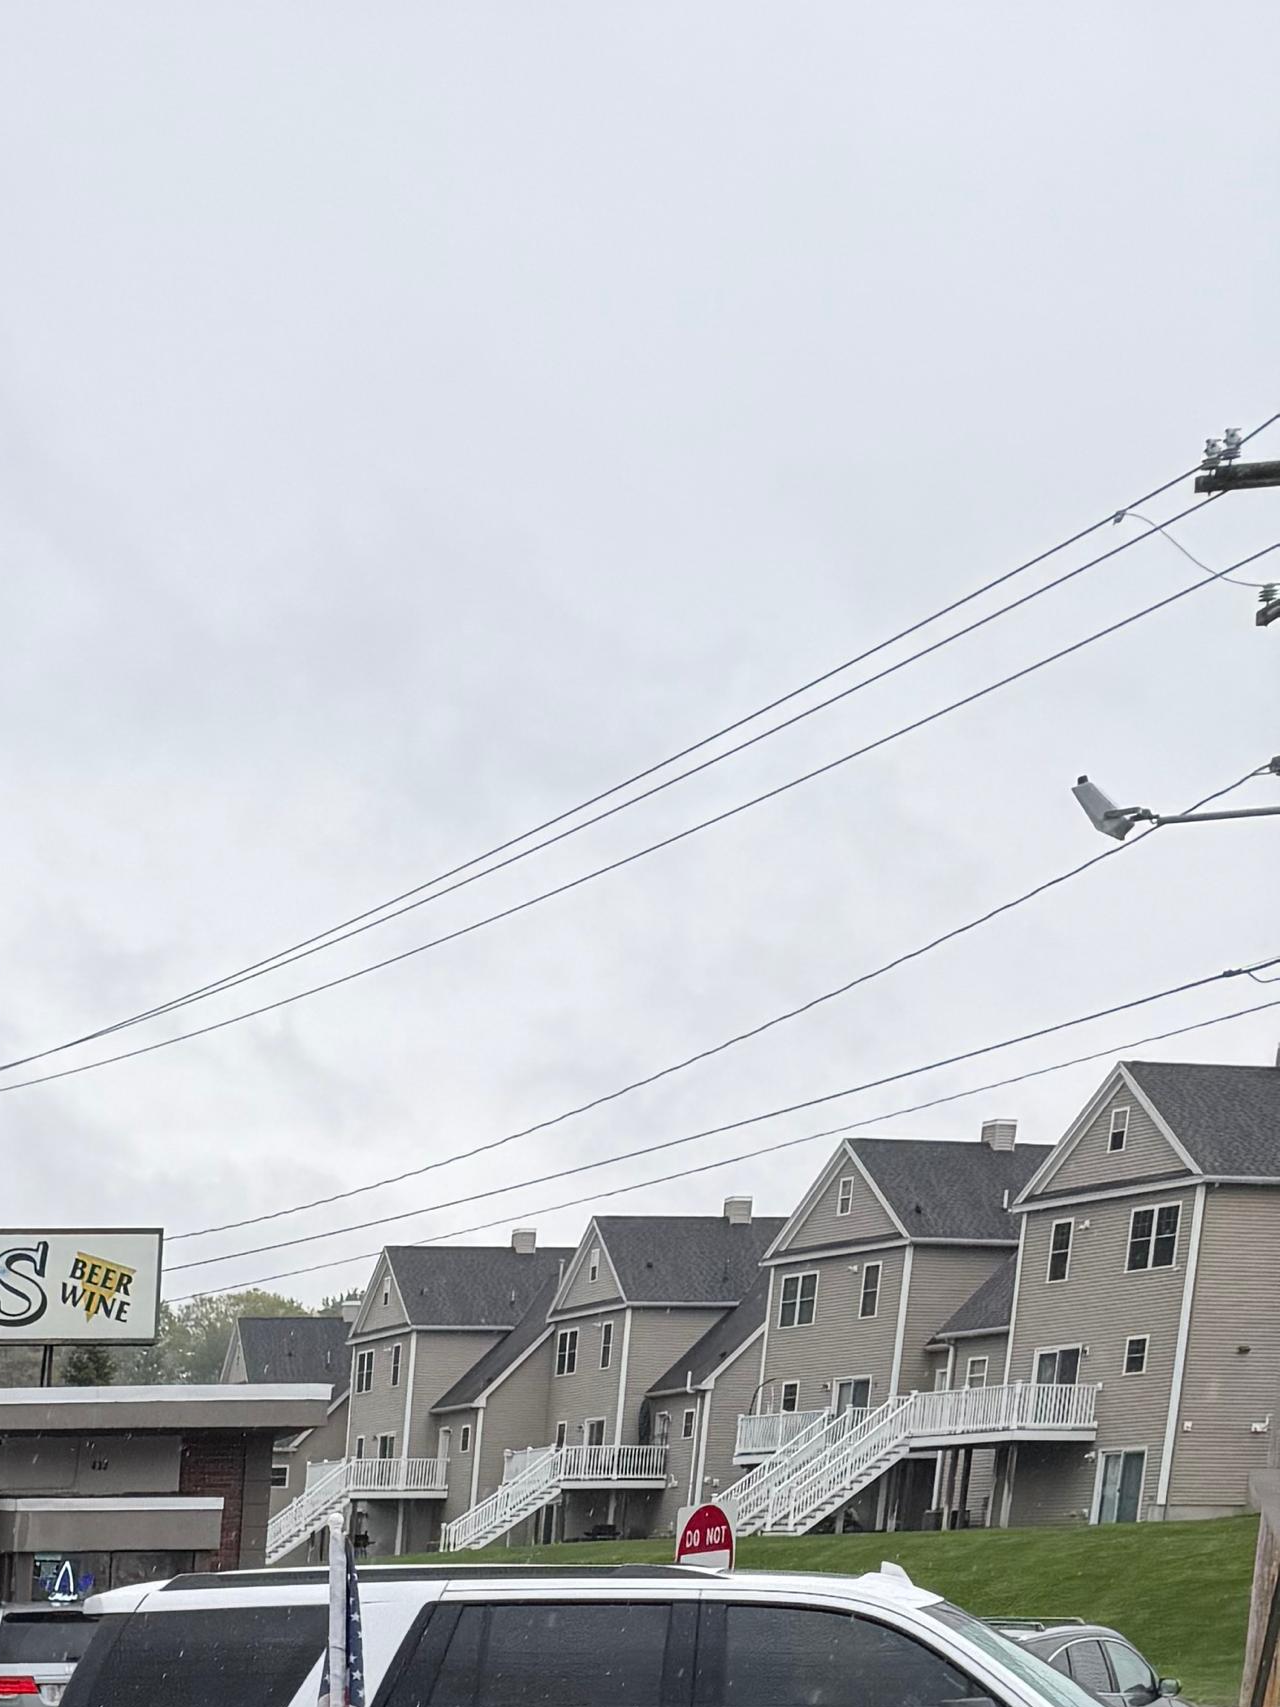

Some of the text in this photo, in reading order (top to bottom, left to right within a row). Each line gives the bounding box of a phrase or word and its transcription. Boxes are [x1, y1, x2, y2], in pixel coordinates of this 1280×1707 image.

[69, 1257, 133, 1296] BEER
[61, 1281, 131, 1323] WINE
[685, 1525, 727, 1548] DO NOT
